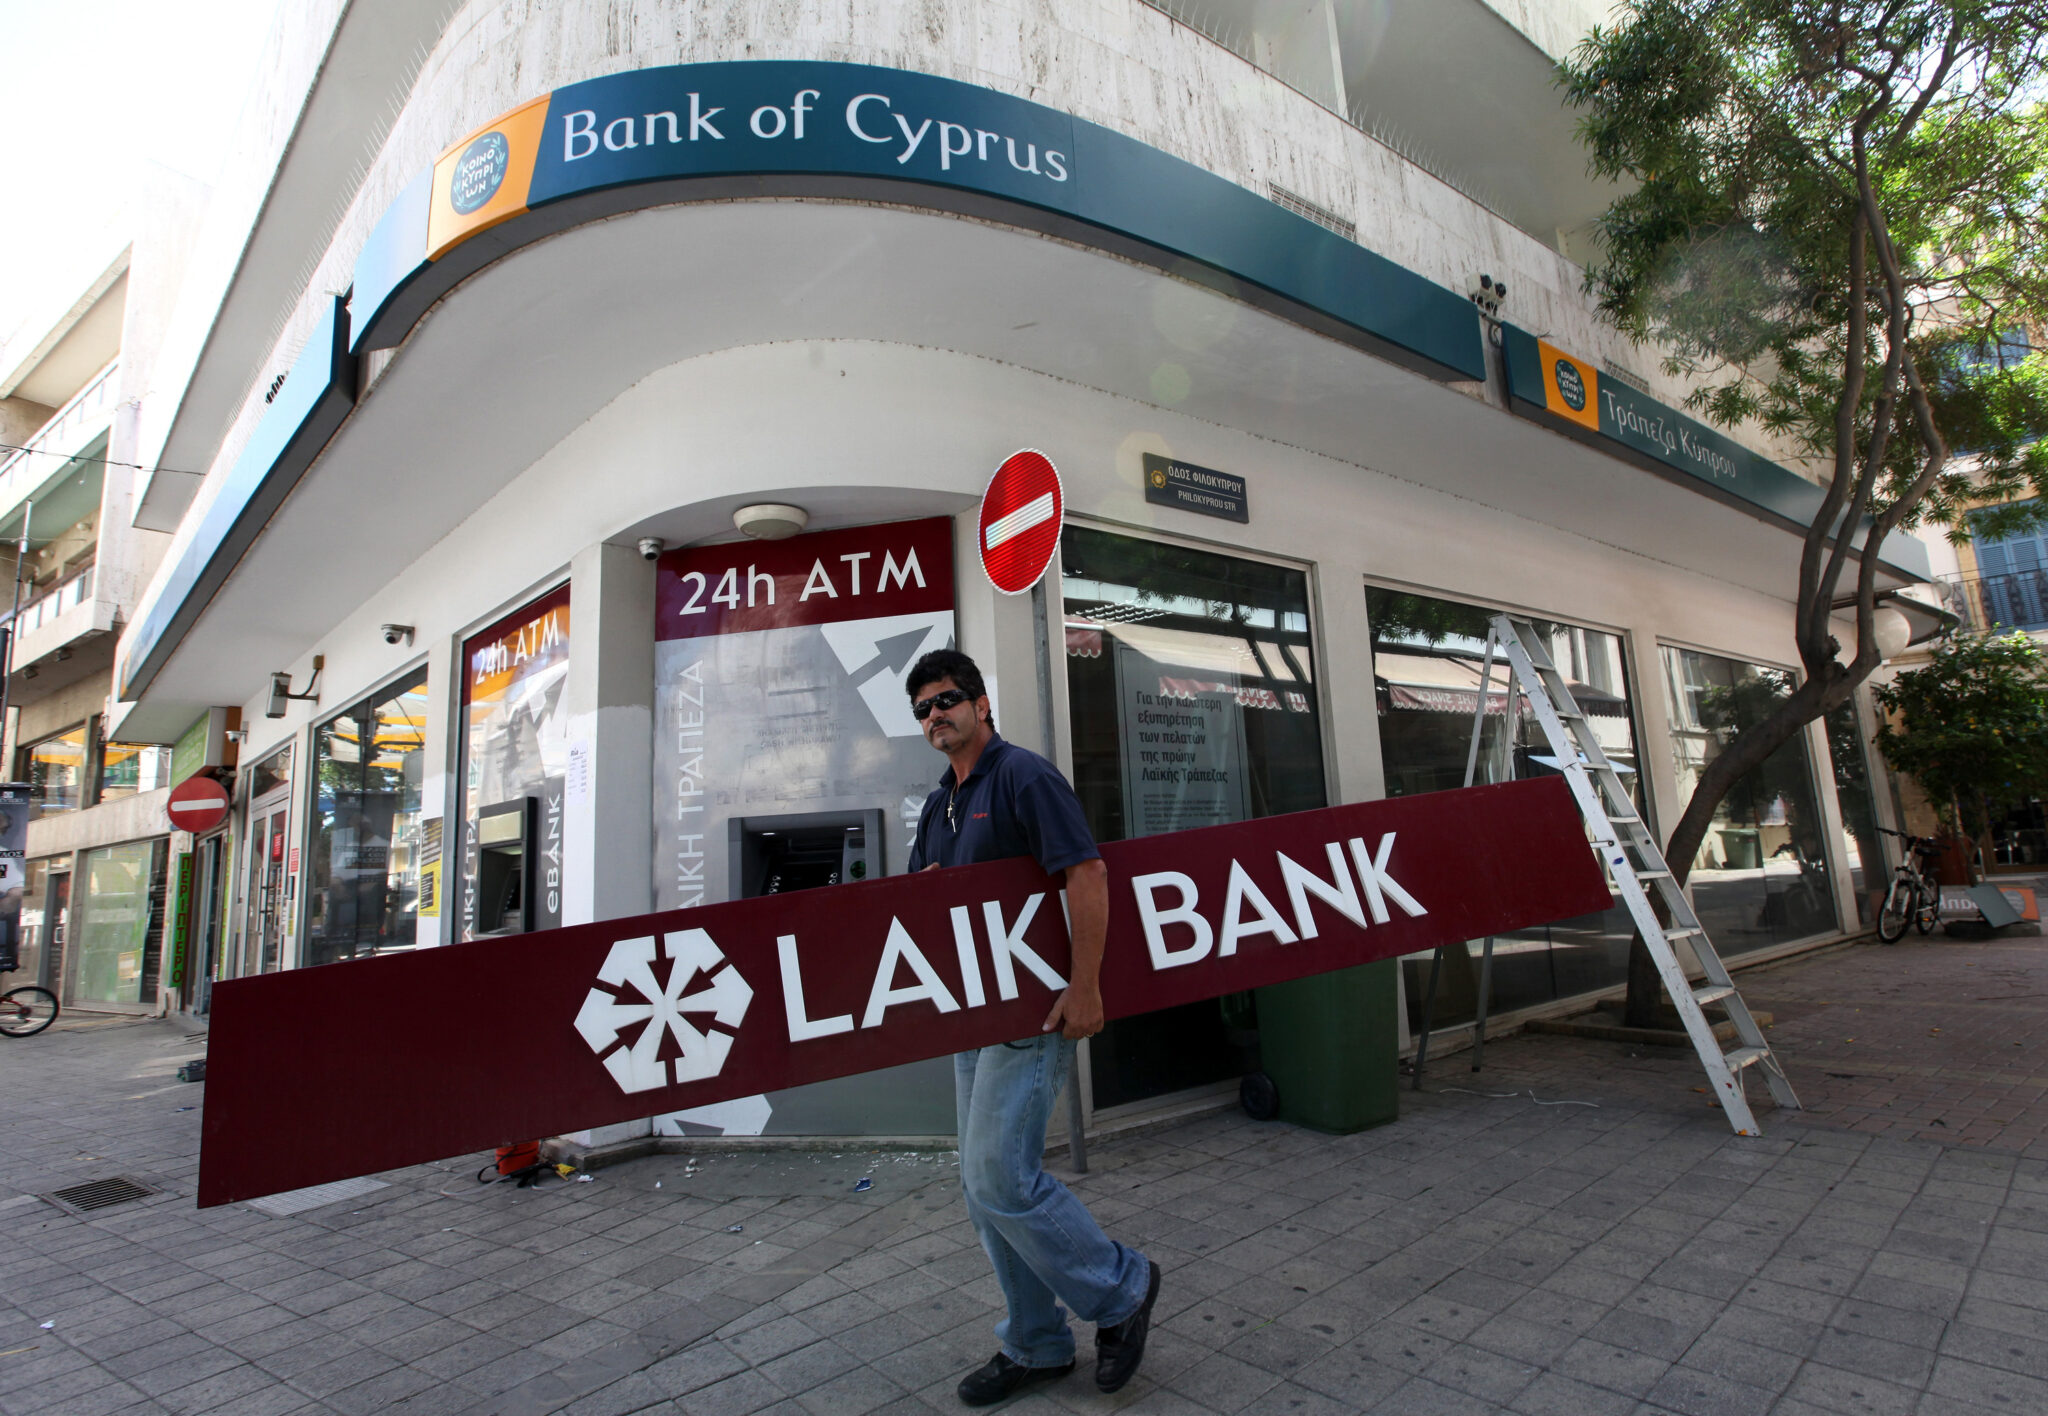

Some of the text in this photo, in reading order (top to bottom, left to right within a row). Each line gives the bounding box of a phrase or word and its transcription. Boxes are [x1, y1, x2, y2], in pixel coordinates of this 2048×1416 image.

[562, 89, 1069, 183] Bank of Cyprus
[1602, 388, 1737, 478] Τράπεζα Κύπρου
[1168, 465, 1242, 493] ΟΔΟΣ ΦΙΛΟΚΥΠΡΟΥ
[1178, 490, 1237, 511] PHILOKYPROU STR
[678, 545, 927, 615] 24h ATM
[475, 609, 559, 685] 24h ATM
[1136, 691, 1153, 705] Για
[1156, 695, 1173, 709] την
[1138, 709, 1205, 729] εξυπηρέτηση
[1139, 730, 1206, 745] των πελατών
[1140, 749, 1196, 765] της πρώην
[677, 660, 704, 909] ΑΙΚΗ ΤΡΑΠΕΖΑ
[1142, 767, 1228, 784] Λαϊκής Τράπεζας
[547, 793, 561, 914] eBANK
[172, 857, 191, 984] ΠΕΡΙΠΤΕΡΟ
[463, 874, 476, 942] ΑΙΚΗ
[777, 832, 1429, 1042] LAIK BANK
